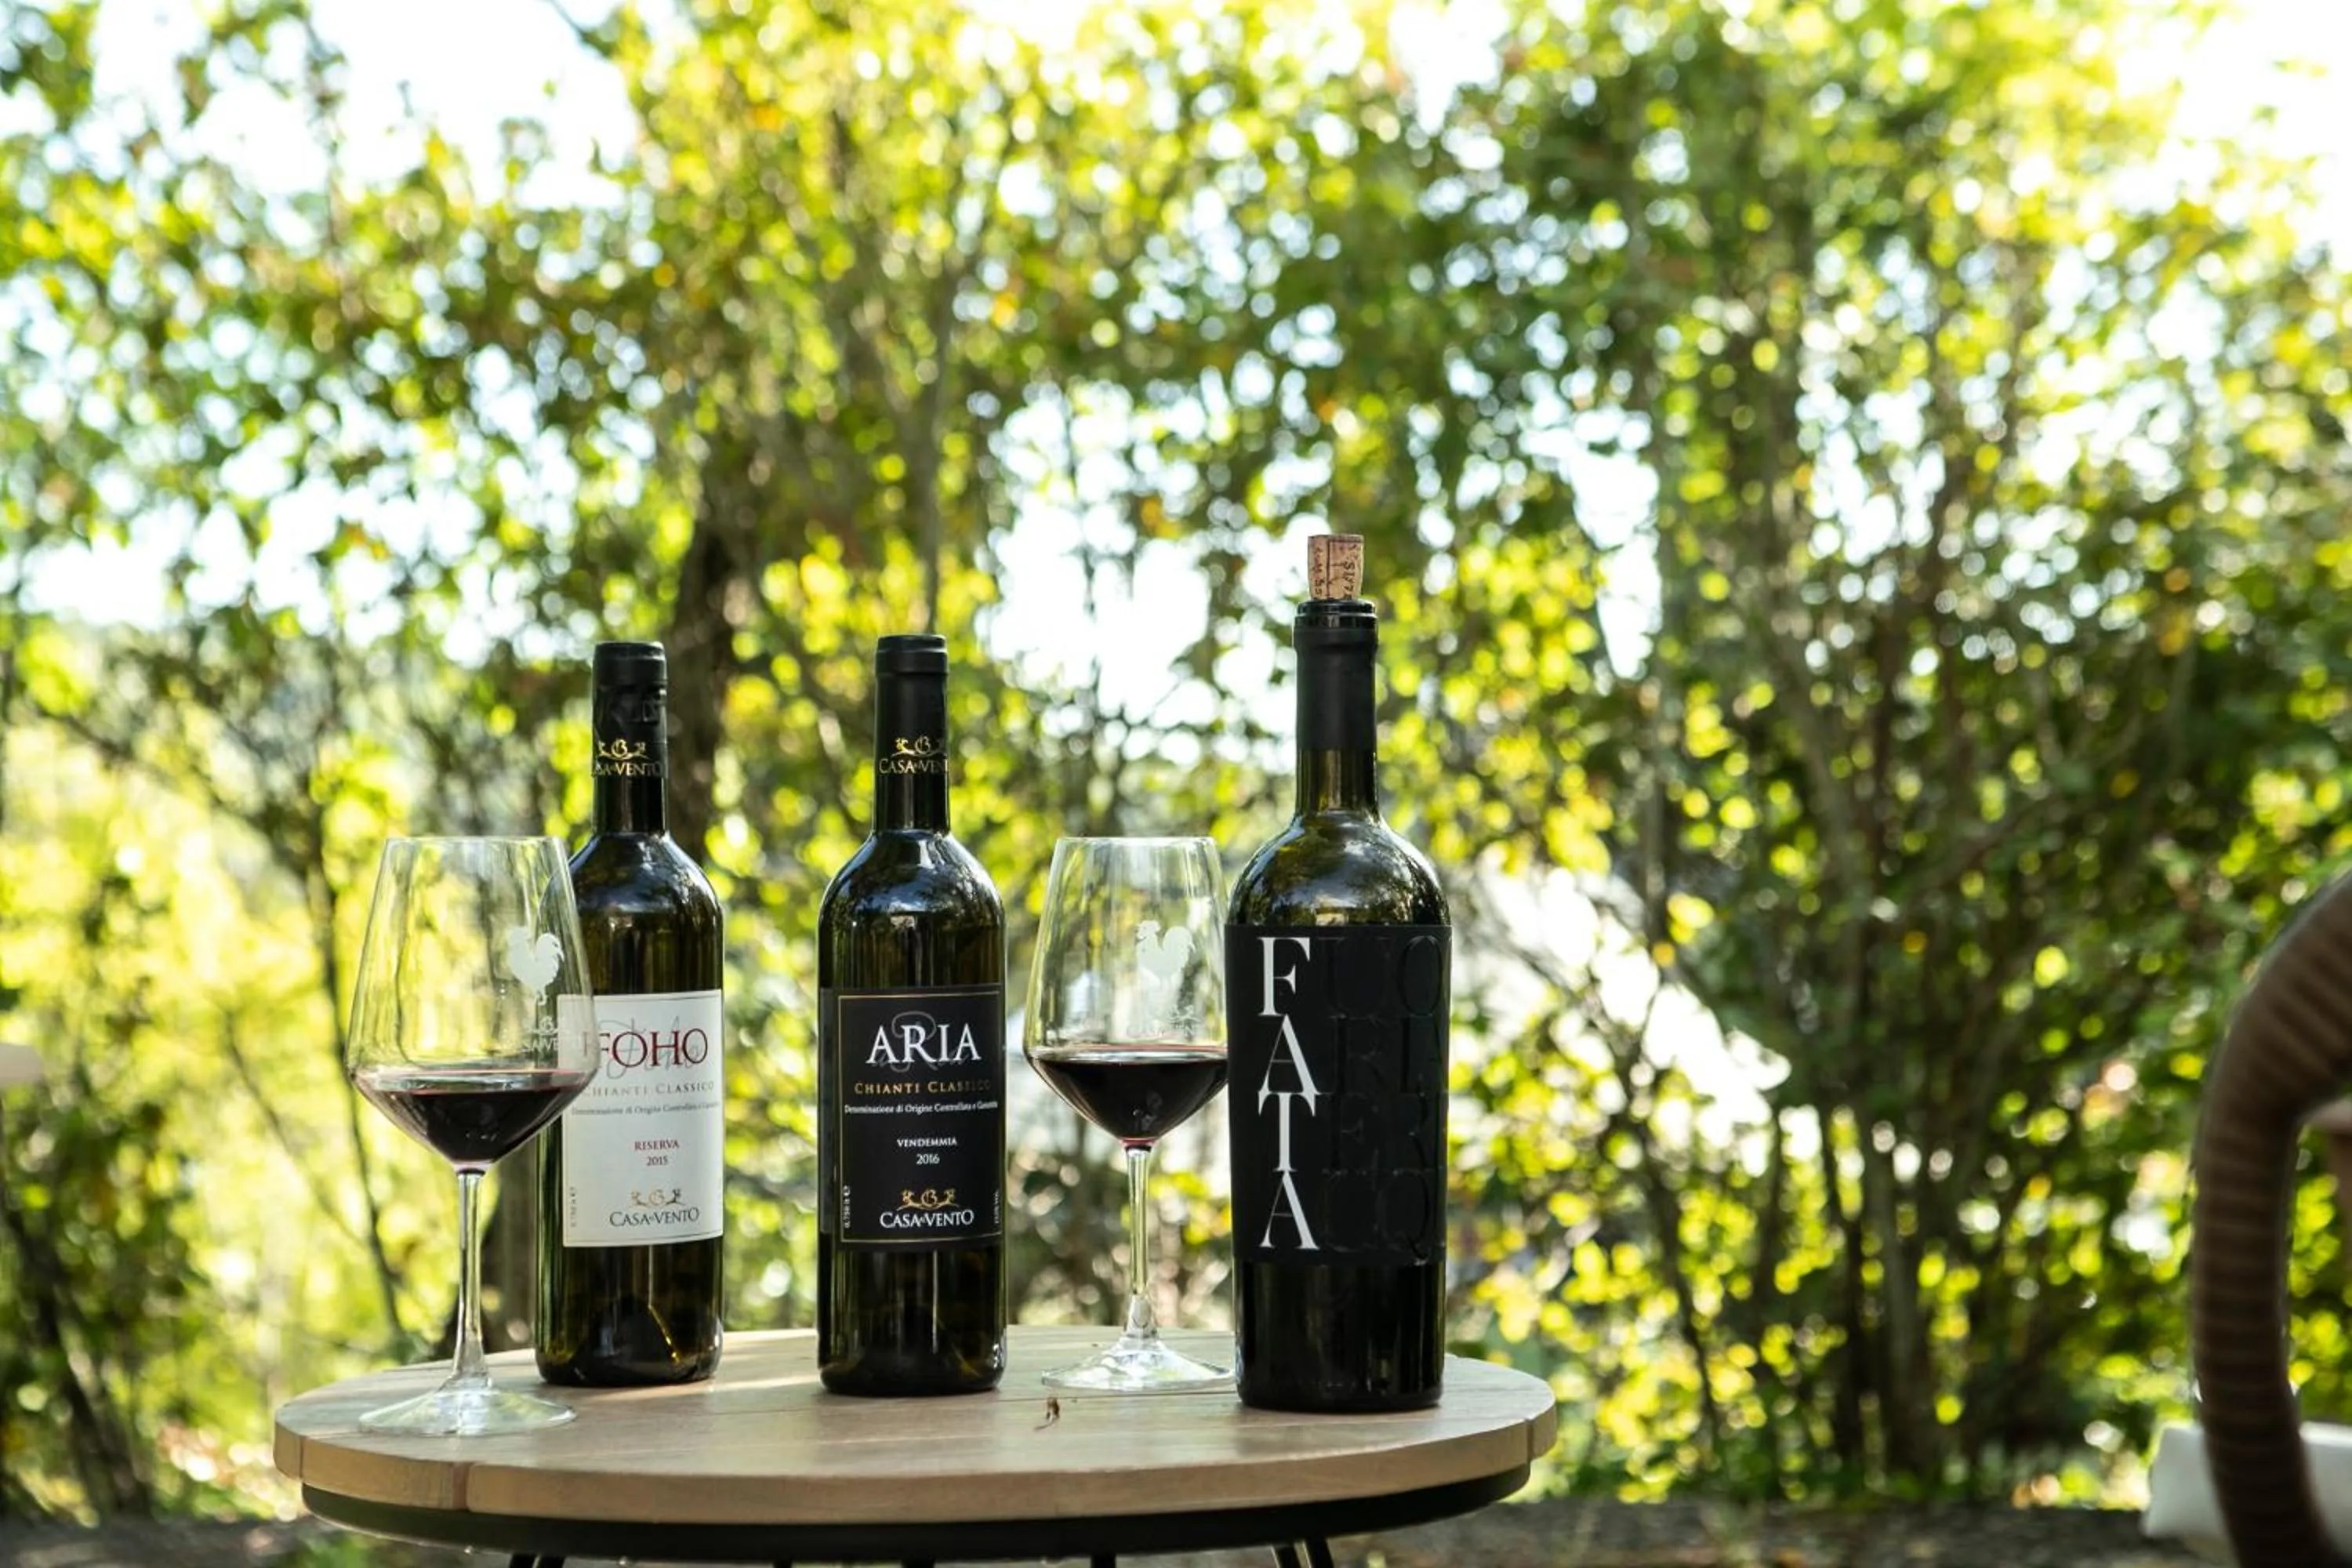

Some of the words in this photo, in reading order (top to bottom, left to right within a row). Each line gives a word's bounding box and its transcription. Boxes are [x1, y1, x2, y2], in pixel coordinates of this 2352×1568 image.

[597, 1028, 708, 1068] FOHO
[866, 1022, 982, 1064] ARIA
[655, 1081, 714, 1094] CLASSICO
[855, 1083, 920, 1094] CHIANTI
[897, 1137, 957, 1147] VENDEMMIA
[647, 1155, 668, 1167] 2015
[916, 1153, 940, 1166] 2016
